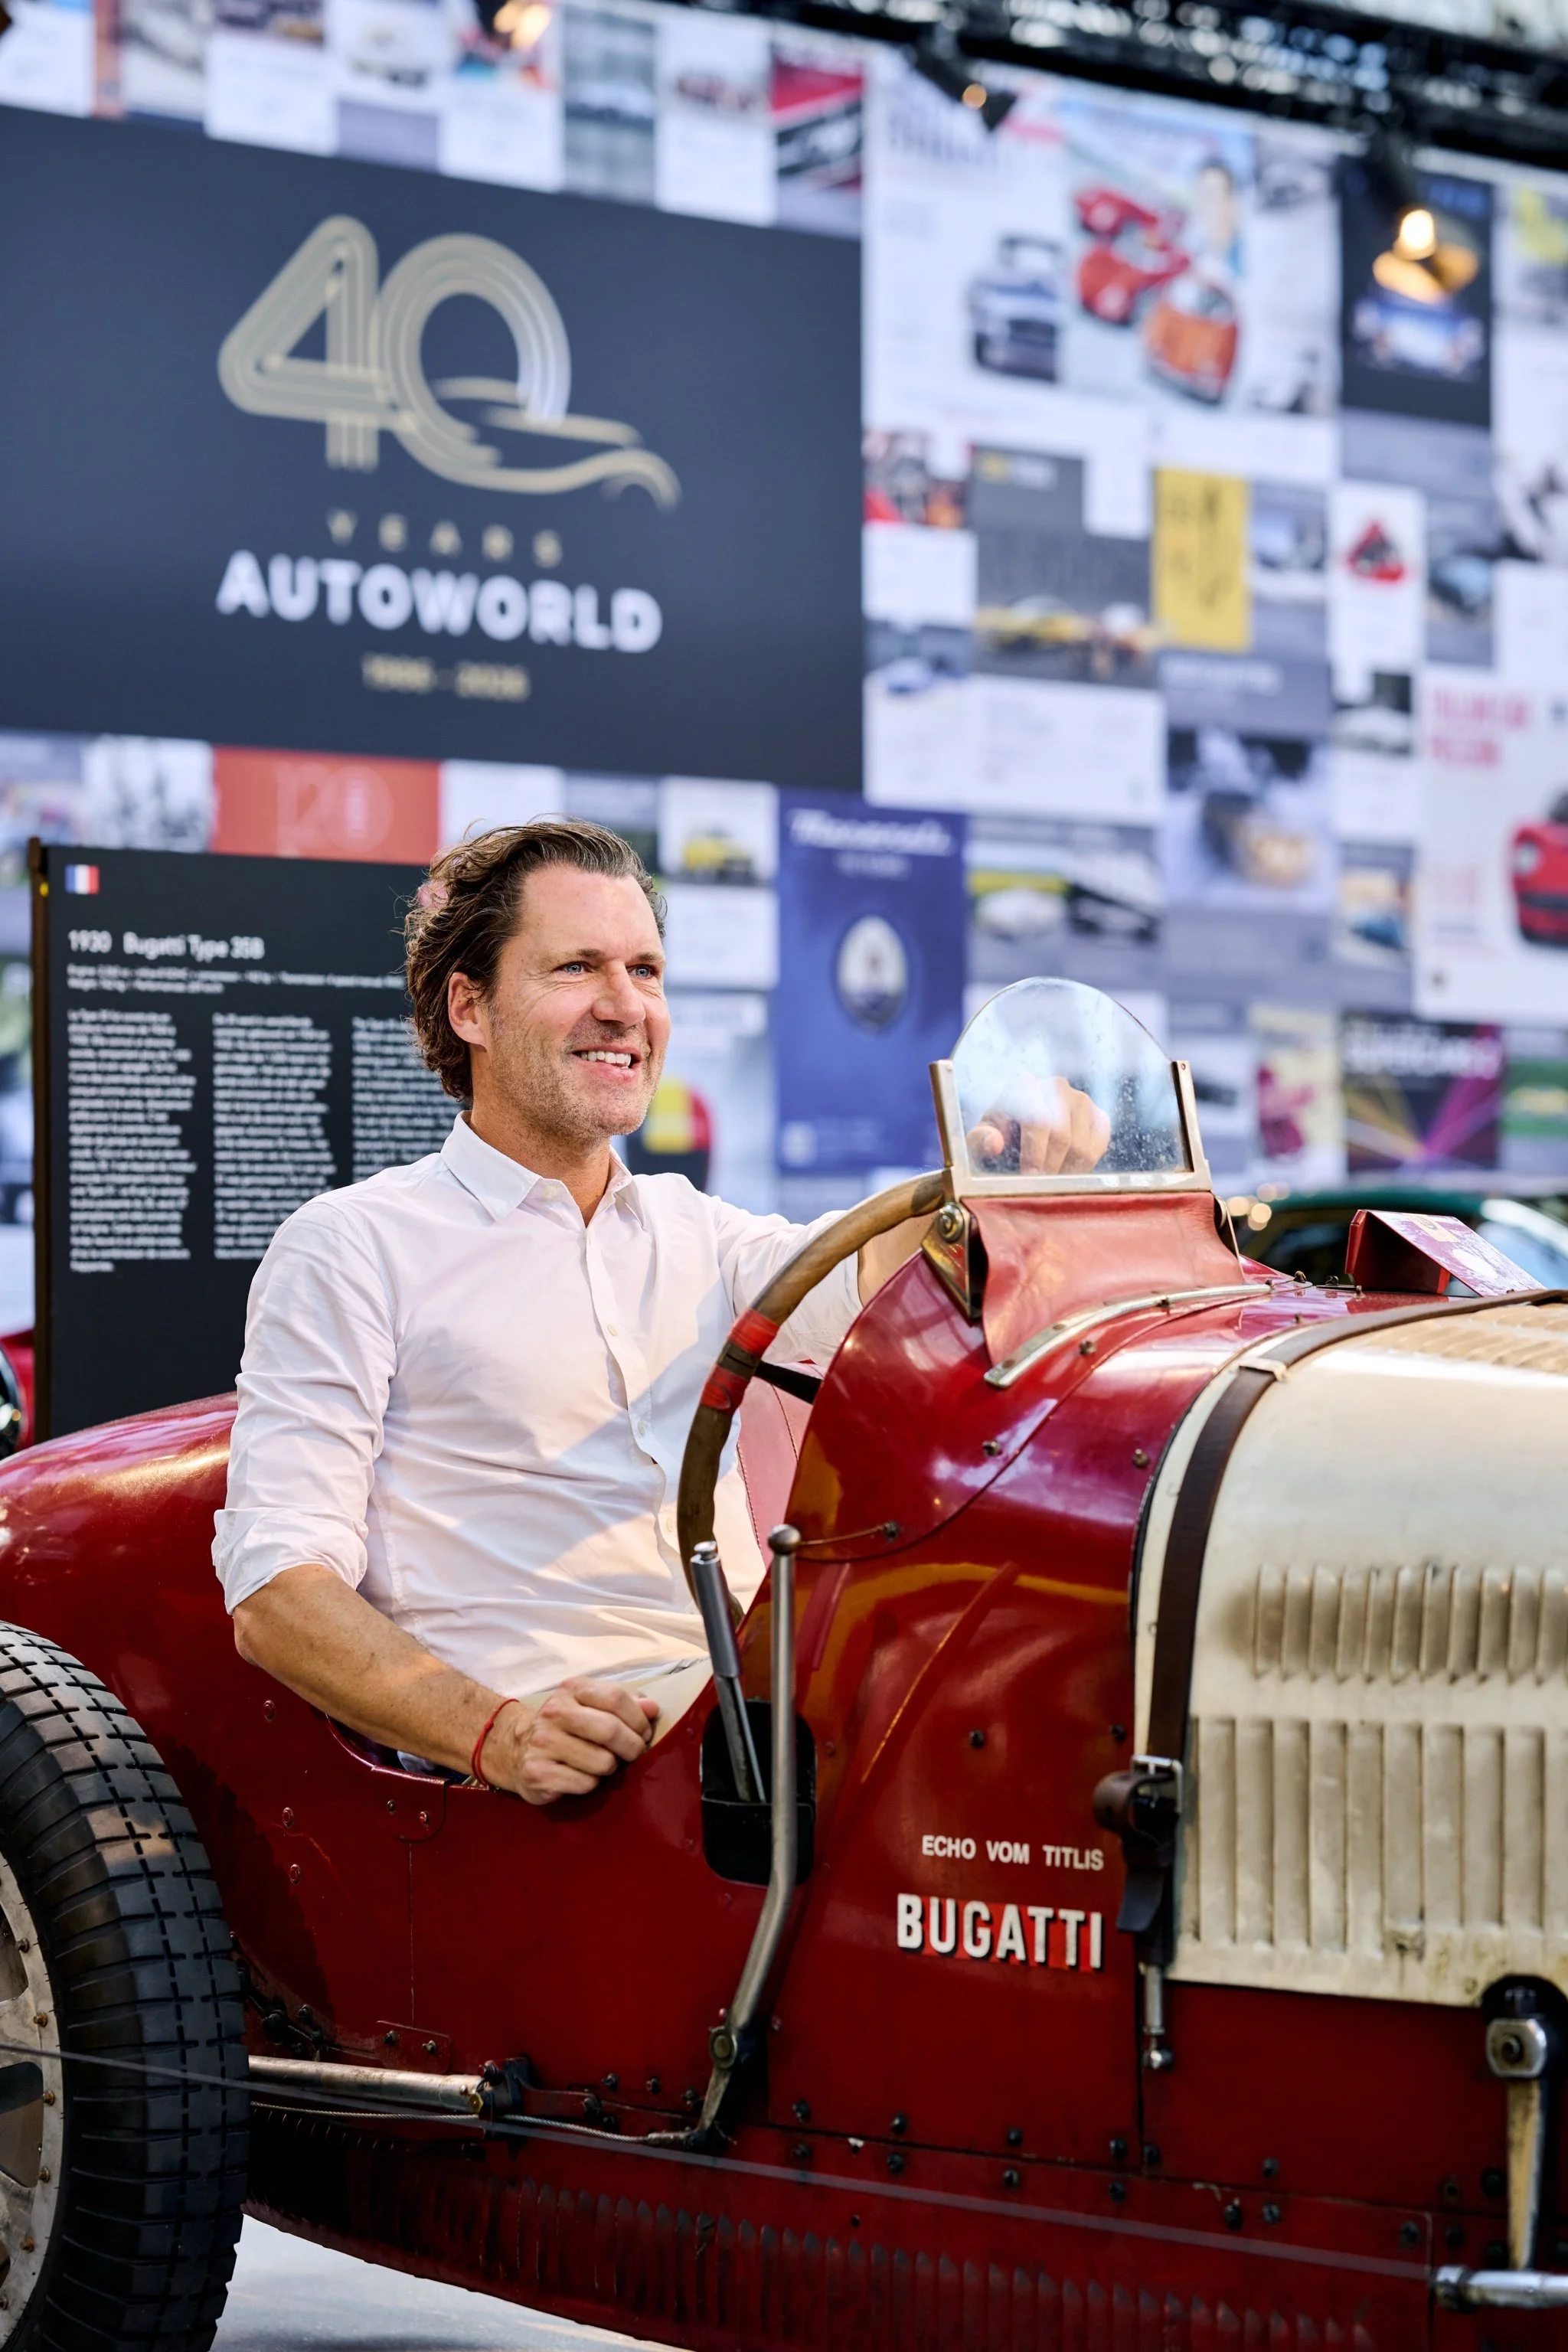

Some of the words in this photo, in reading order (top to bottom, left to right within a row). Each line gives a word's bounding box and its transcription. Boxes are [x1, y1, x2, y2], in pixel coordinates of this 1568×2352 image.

[218, 214, 681, 508] 40
[326, 508, 564, 570] YEARS
[216, 549, 662, 654] AUTOWORLD
[123, 932, 186, 960] Bugatti
[188, 933, 229, 962] Type
[922, 1834, 977, 1860] ECHO
[986, 1840, 1030, 1865] VOM
[1042, 1844, 1104, 1871] TITLIS
[897, 1893, 1104, 1970] BUGATTI
